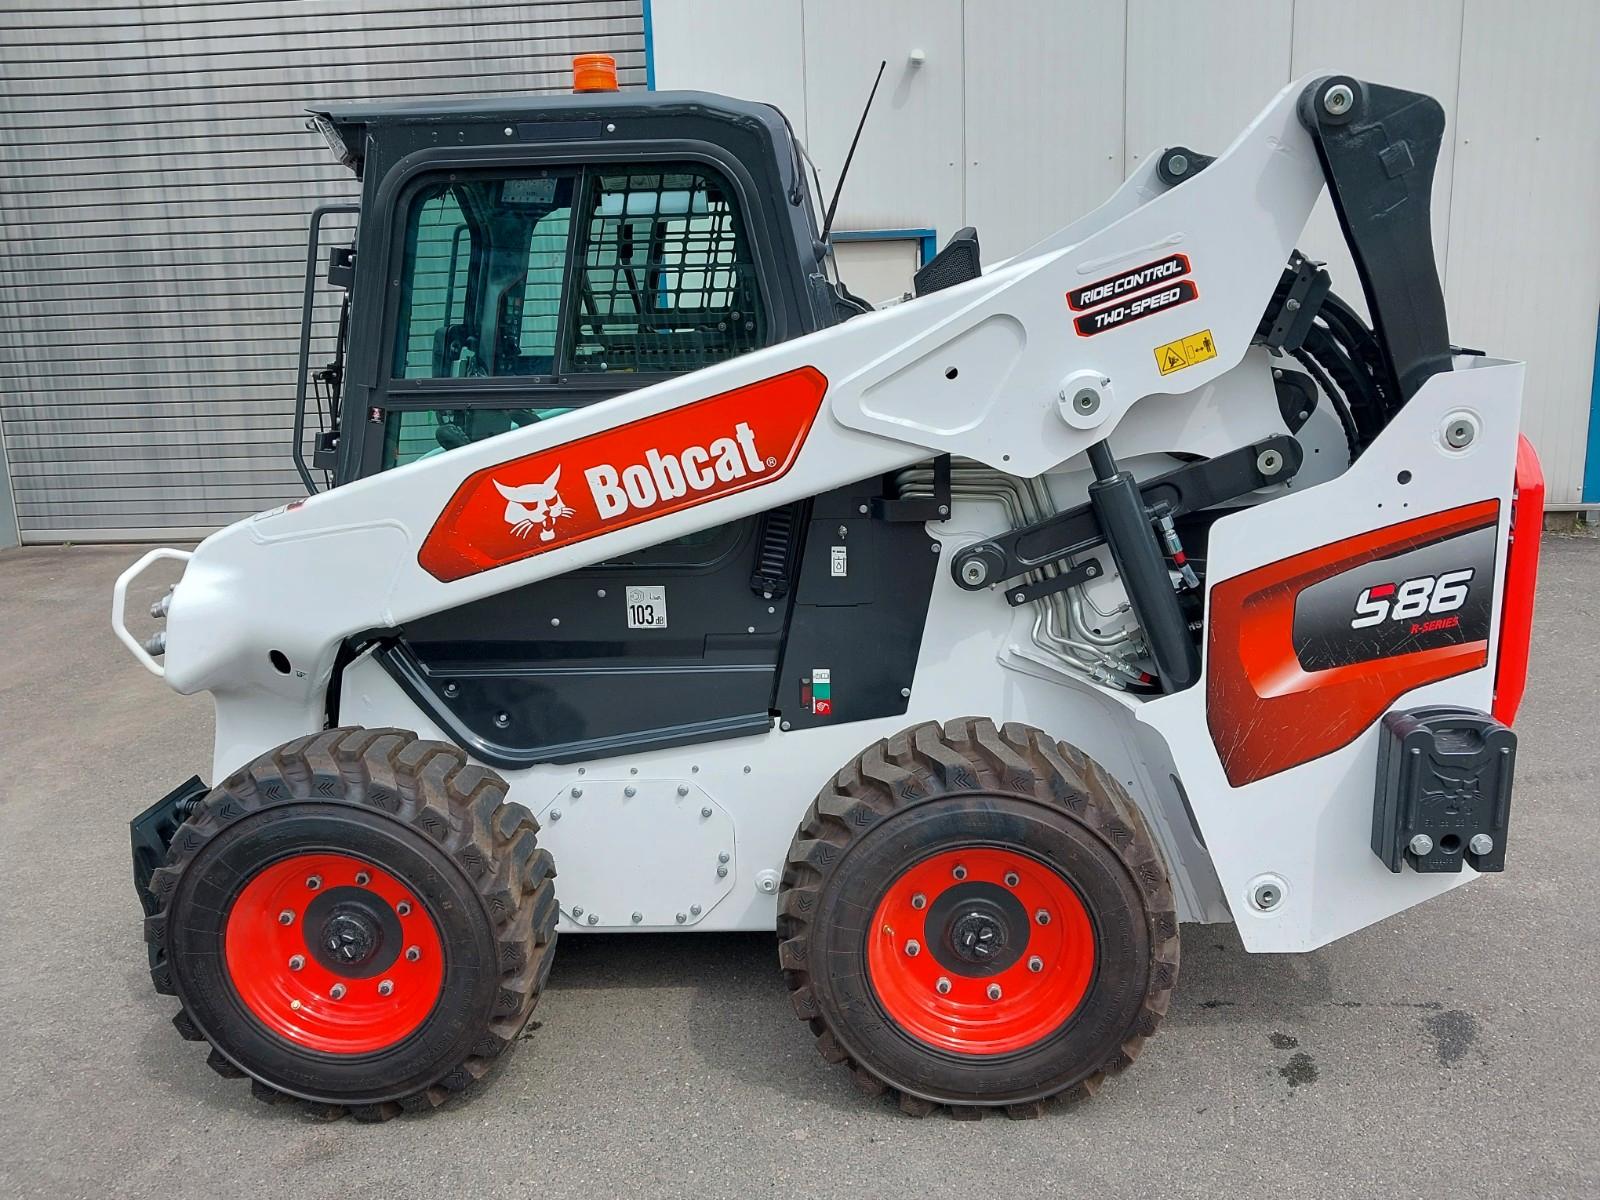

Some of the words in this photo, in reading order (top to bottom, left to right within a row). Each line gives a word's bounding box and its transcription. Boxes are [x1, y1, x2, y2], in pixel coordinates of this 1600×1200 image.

[1080, 282, 1114, 306] RIDE
[1114, 260, 1182, 292] CONTROL
[1095, 287, 1181, 328] TWO-SPEED
[584, 422, 766, 520] Bobcat
[630, 604, 655, 625] 103
[1351, 569, 1474, 629] S86
[1410, 615, 1459, 635] R-SERIES
